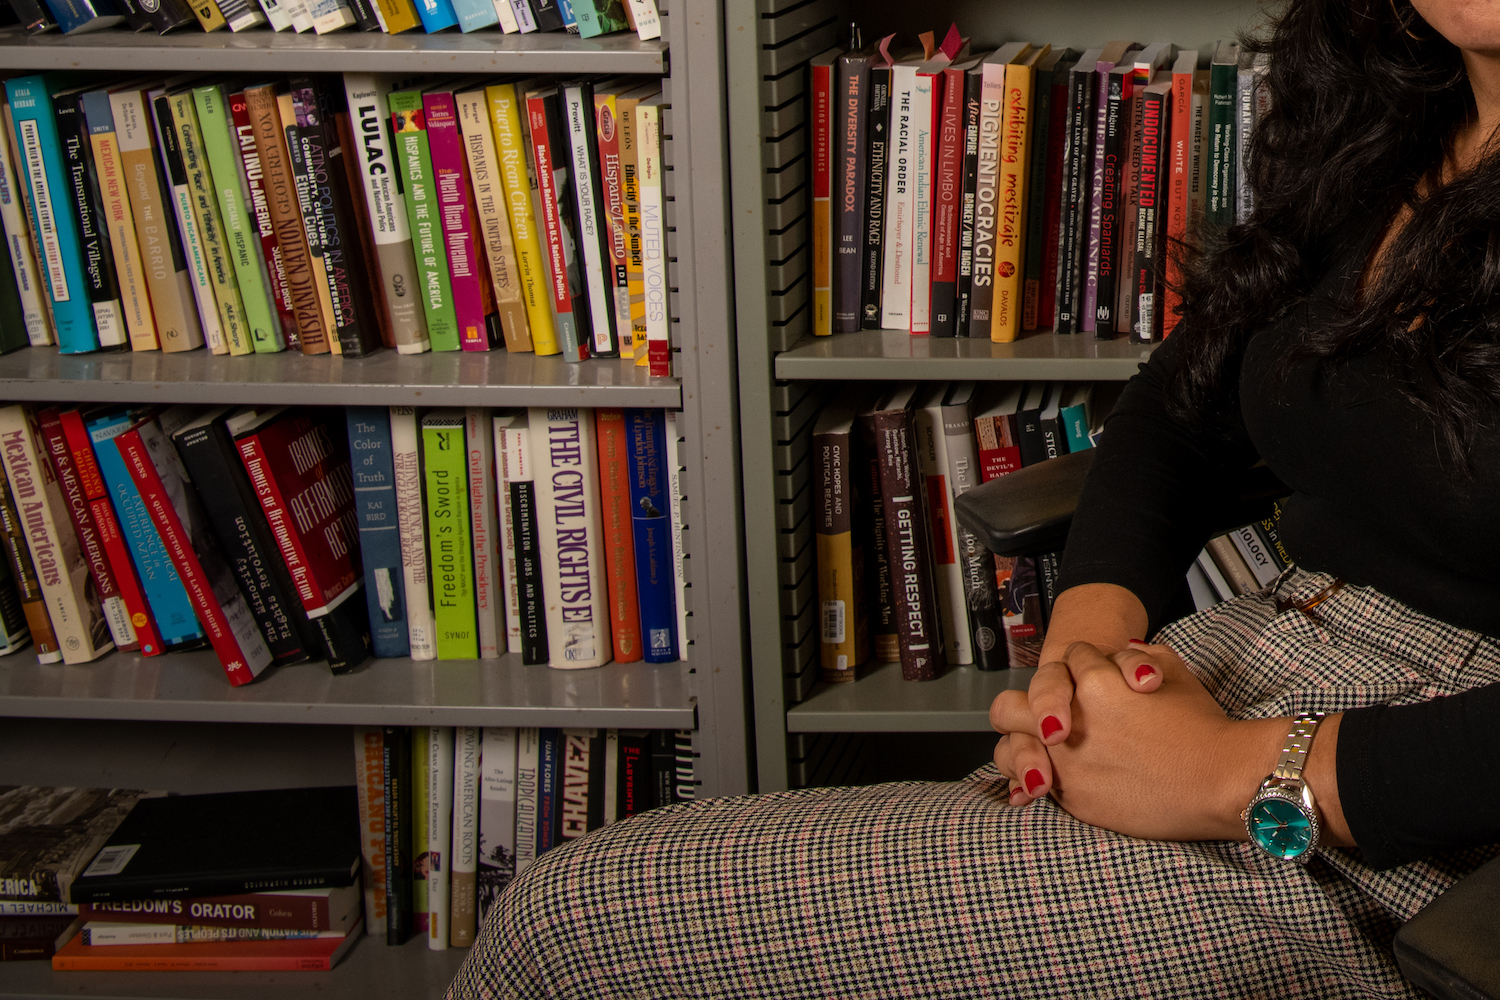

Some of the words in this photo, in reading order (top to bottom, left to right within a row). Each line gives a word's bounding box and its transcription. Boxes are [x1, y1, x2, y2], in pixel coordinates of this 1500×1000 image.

[848, 75, 860, 102] THE
[902, 91, 910, 112] THE
[66, 134, 80, 149] The
[358, 104, 387, 176] LULAC
[571, 101, 581, 133] Prewitt
[846, 103, 859, 156] DIVERSITY
[898, 114, 910, 154] RACIAL
[100, 139, 114, 174] MEXICAN
[896, 158, 908, 195] ORDER
[1140, 100, 1161, 208] UNDOCUMENTED
[68, 149, 95, 238] Transnational
[106, 178, 119, 197] NEW
[844, 157, 858, 213] PARADOX
[974, 100, 1002, 288] PIGMENTOCRACIES
[1102, 154, 1118, 206] Creating
[110, 197, 125, 222] YORK
[644, 204, 662, 262] MUTED
[842, 234, 853, 243] LEE
[1100, 209, 1116, 278] Spaniards
[86, 239, 102, 290] Villagers
[646, 262, 665, 322] VOICES
[354, 439, 382, 451] Color
[356, 423, 376, 434] The
[548, 420, 582, 468] THE
[356, 471, 386, 484] Truth
[363, 455, 374, 466] of
[1, 428, 37, 498] Mexican
[22, 499, 62, 588] Americans
[366, 512, 387, 522] BIRD
[432, 469, 452, 518] Sword
[552, 471, 588, 526] CIVIL
[896, 508, 916, 570] GETTING
[433, 523, 458, 608] Freedom's
[556, 528, 594, 604] RIGHTS
[903, 574, 924, 638] RESPECT
[562, 732, 591, 838] CHAVEZ
